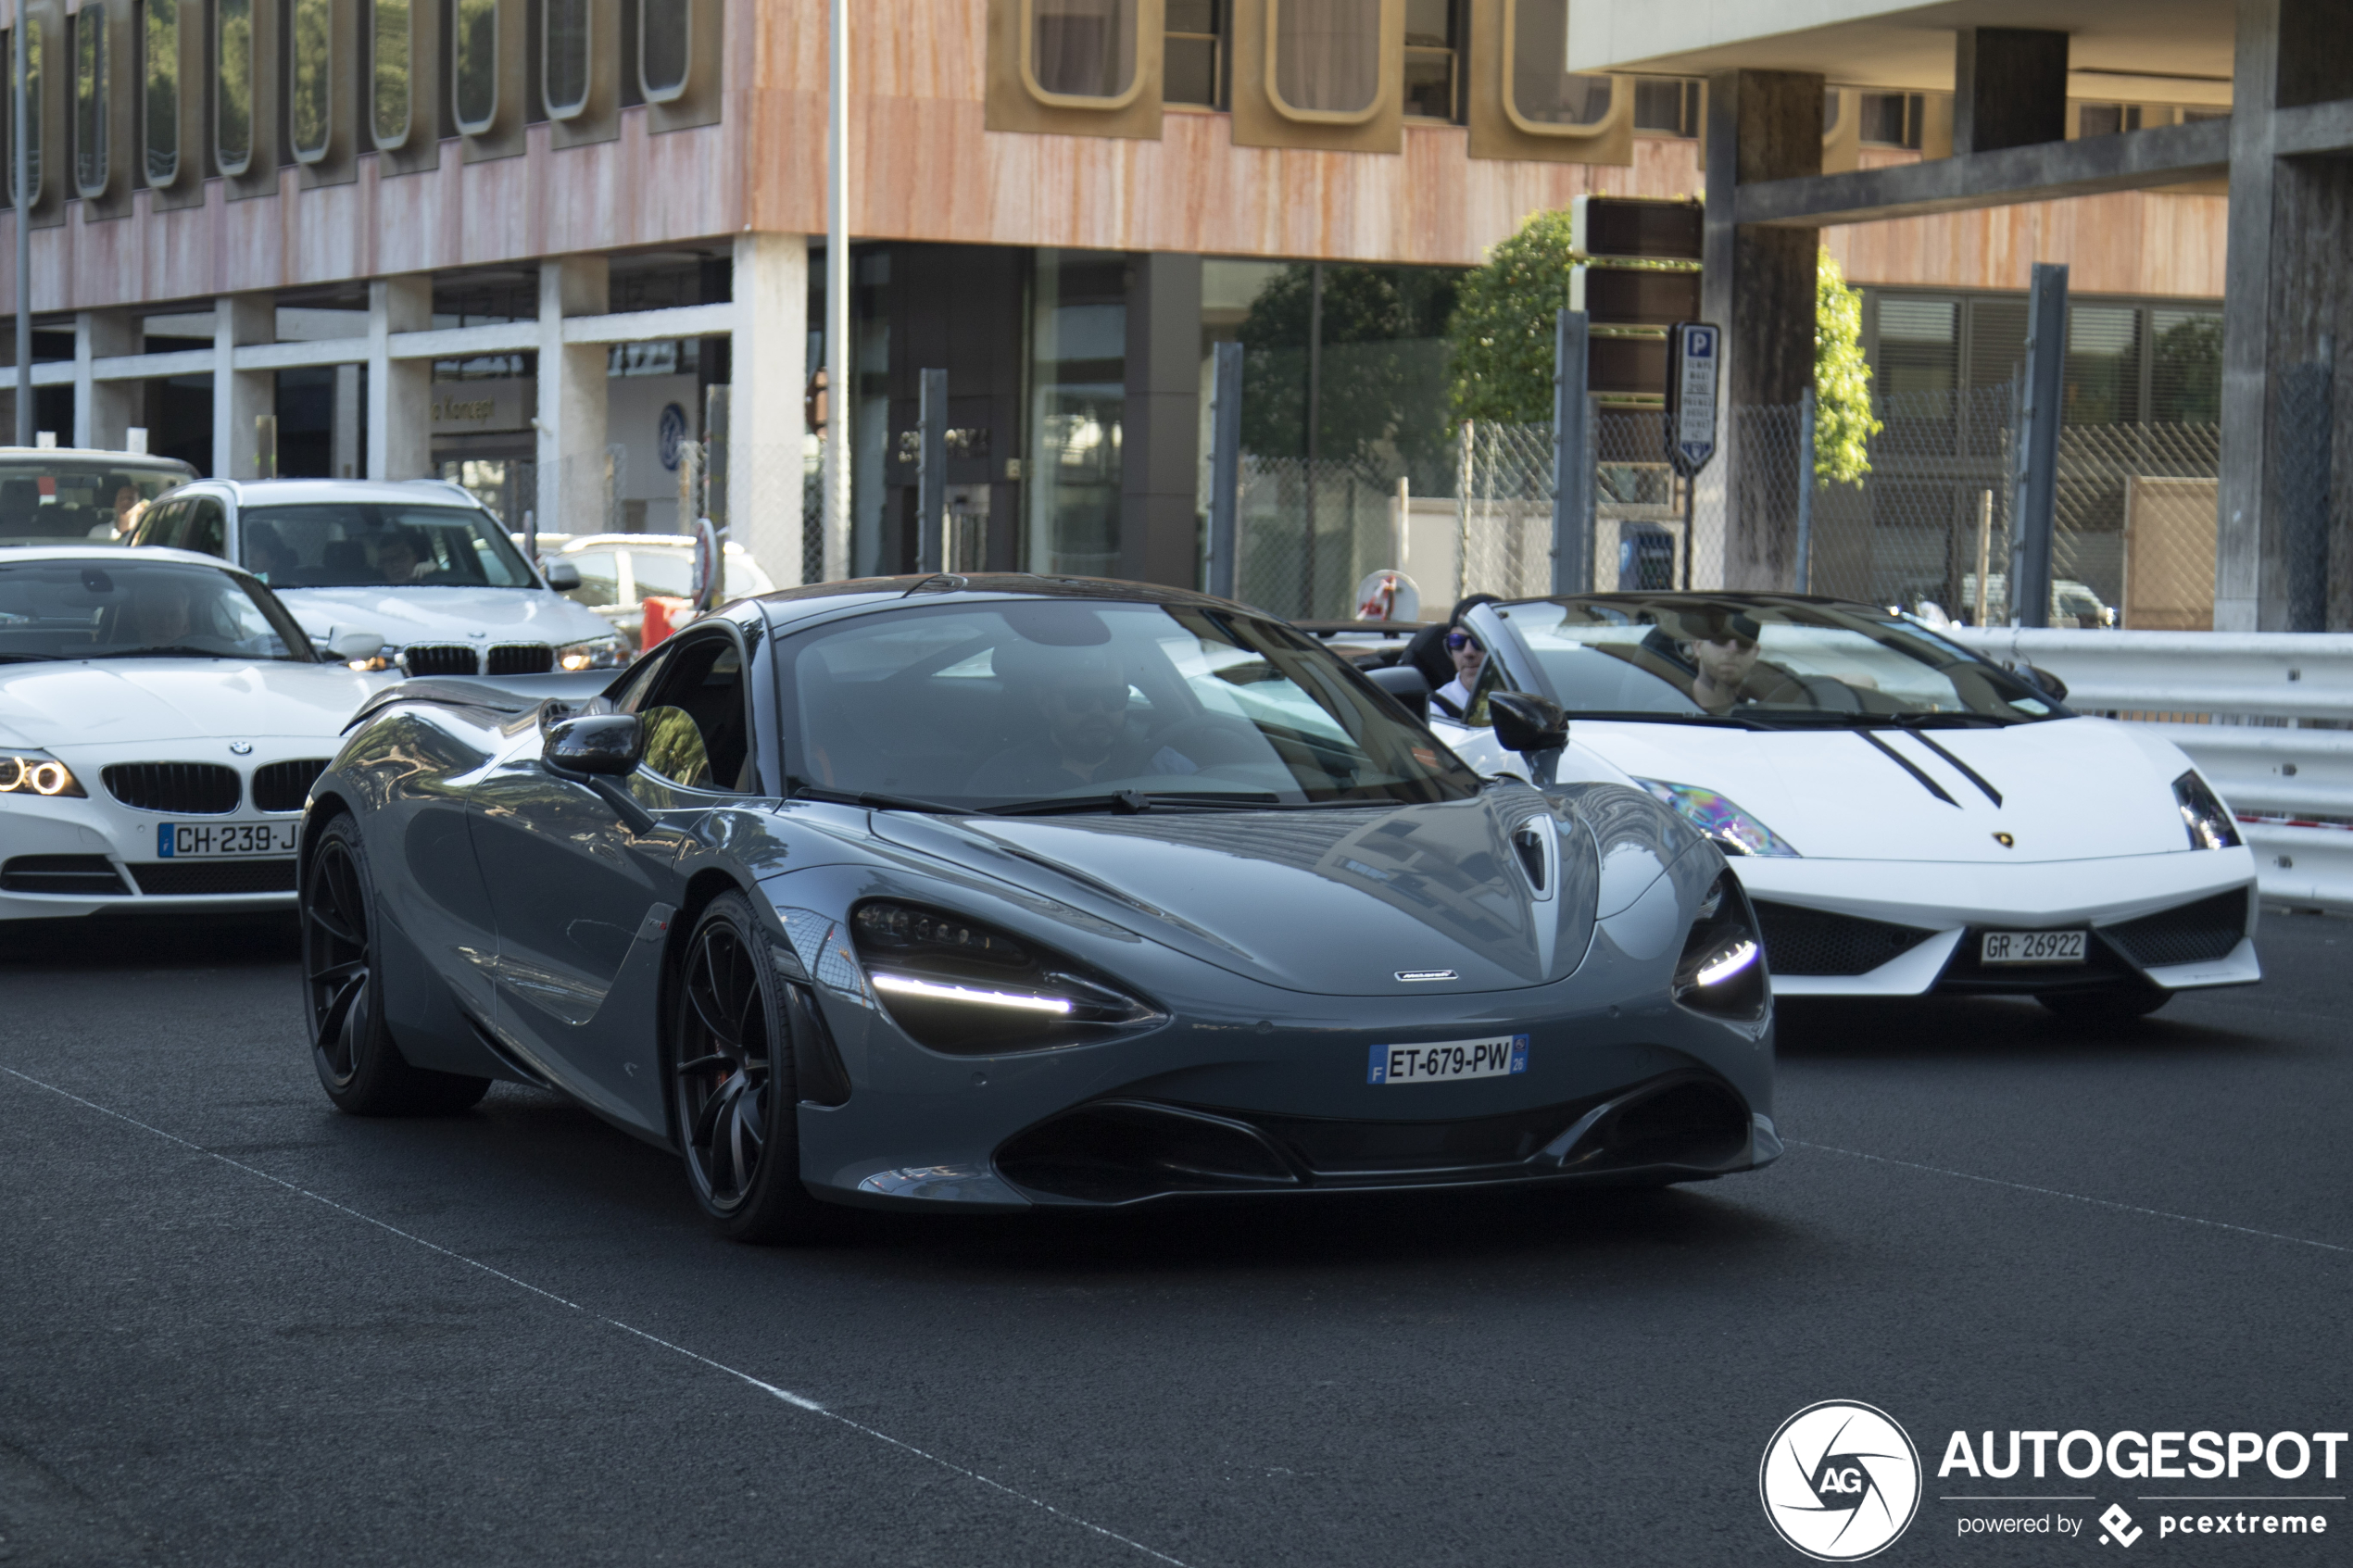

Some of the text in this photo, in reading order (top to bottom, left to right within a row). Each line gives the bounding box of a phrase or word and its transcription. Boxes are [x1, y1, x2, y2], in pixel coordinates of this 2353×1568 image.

[1692, 332, 1707, 355] P
[176, 824, 296, 853] CH-239-J
[1372, 1041, 1525, 1082] F ET-679-PW 26
